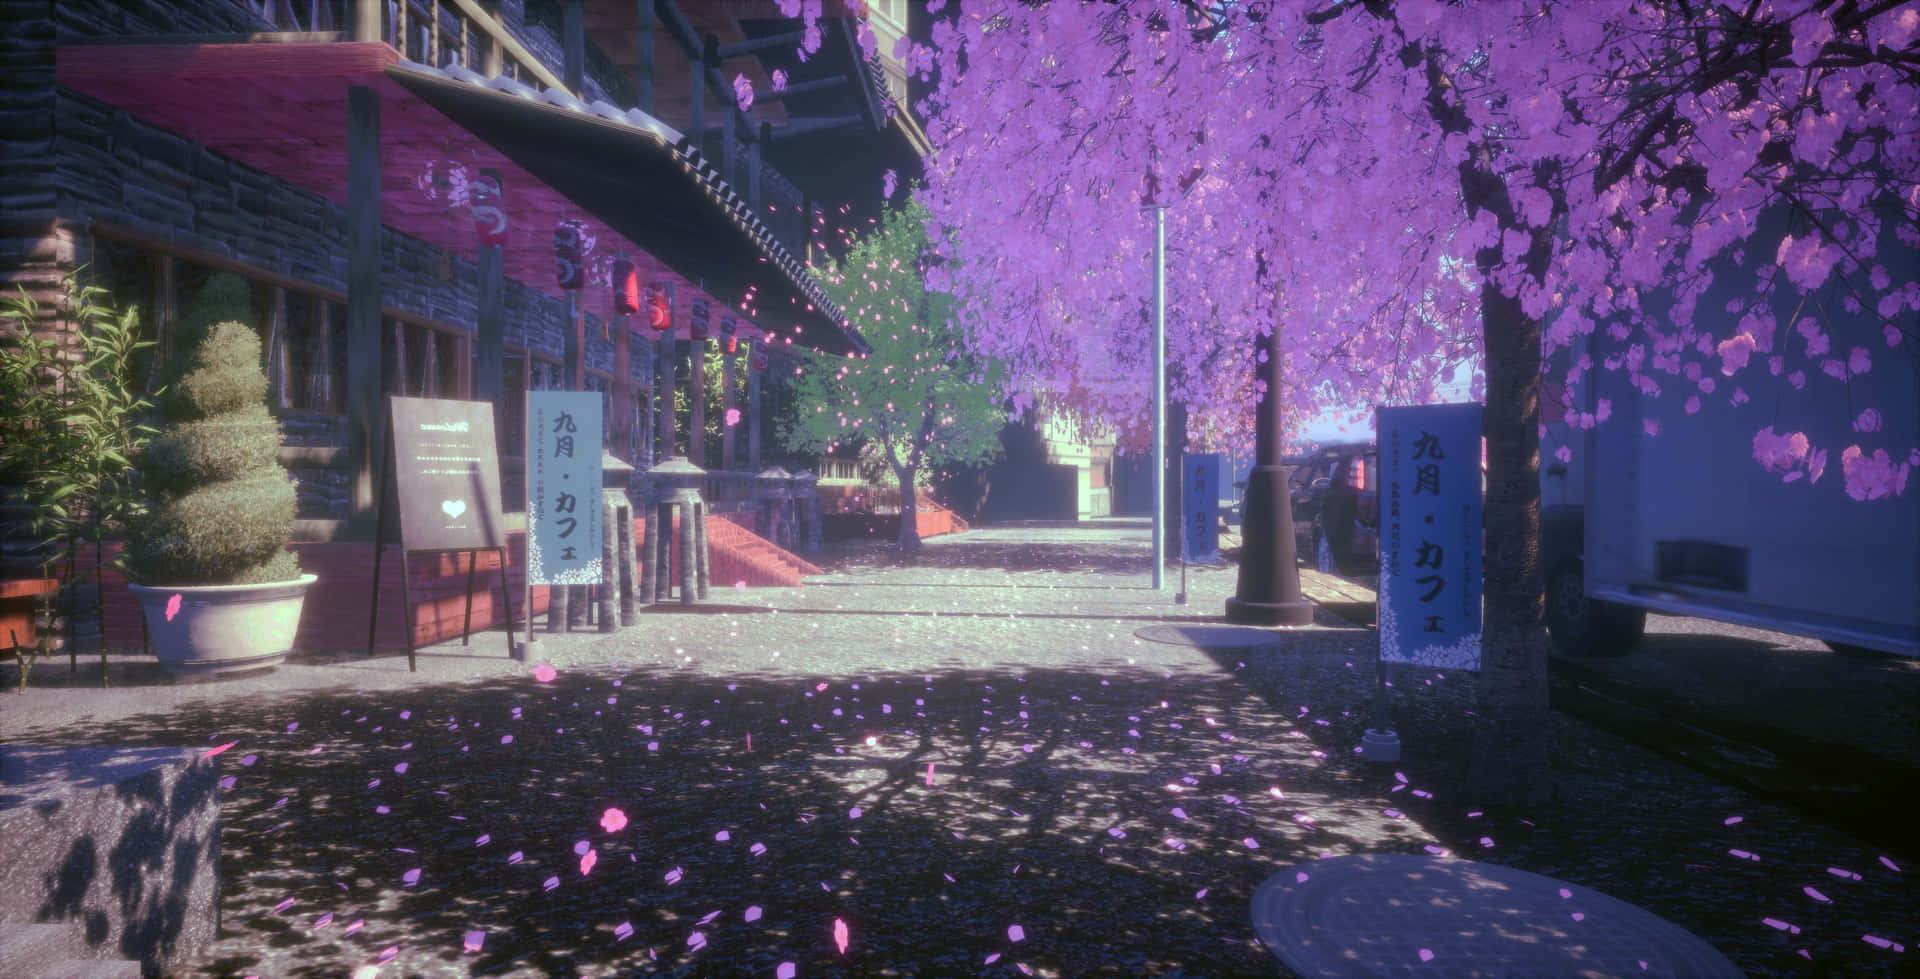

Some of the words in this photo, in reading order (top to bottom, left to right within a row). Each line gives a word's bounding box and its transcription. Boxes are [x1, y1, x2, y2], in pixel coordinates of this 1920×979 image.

[552, 409, 578, 561] 九月・カフェ
[1411, 429, 1446, 632] 九月・カフェ
